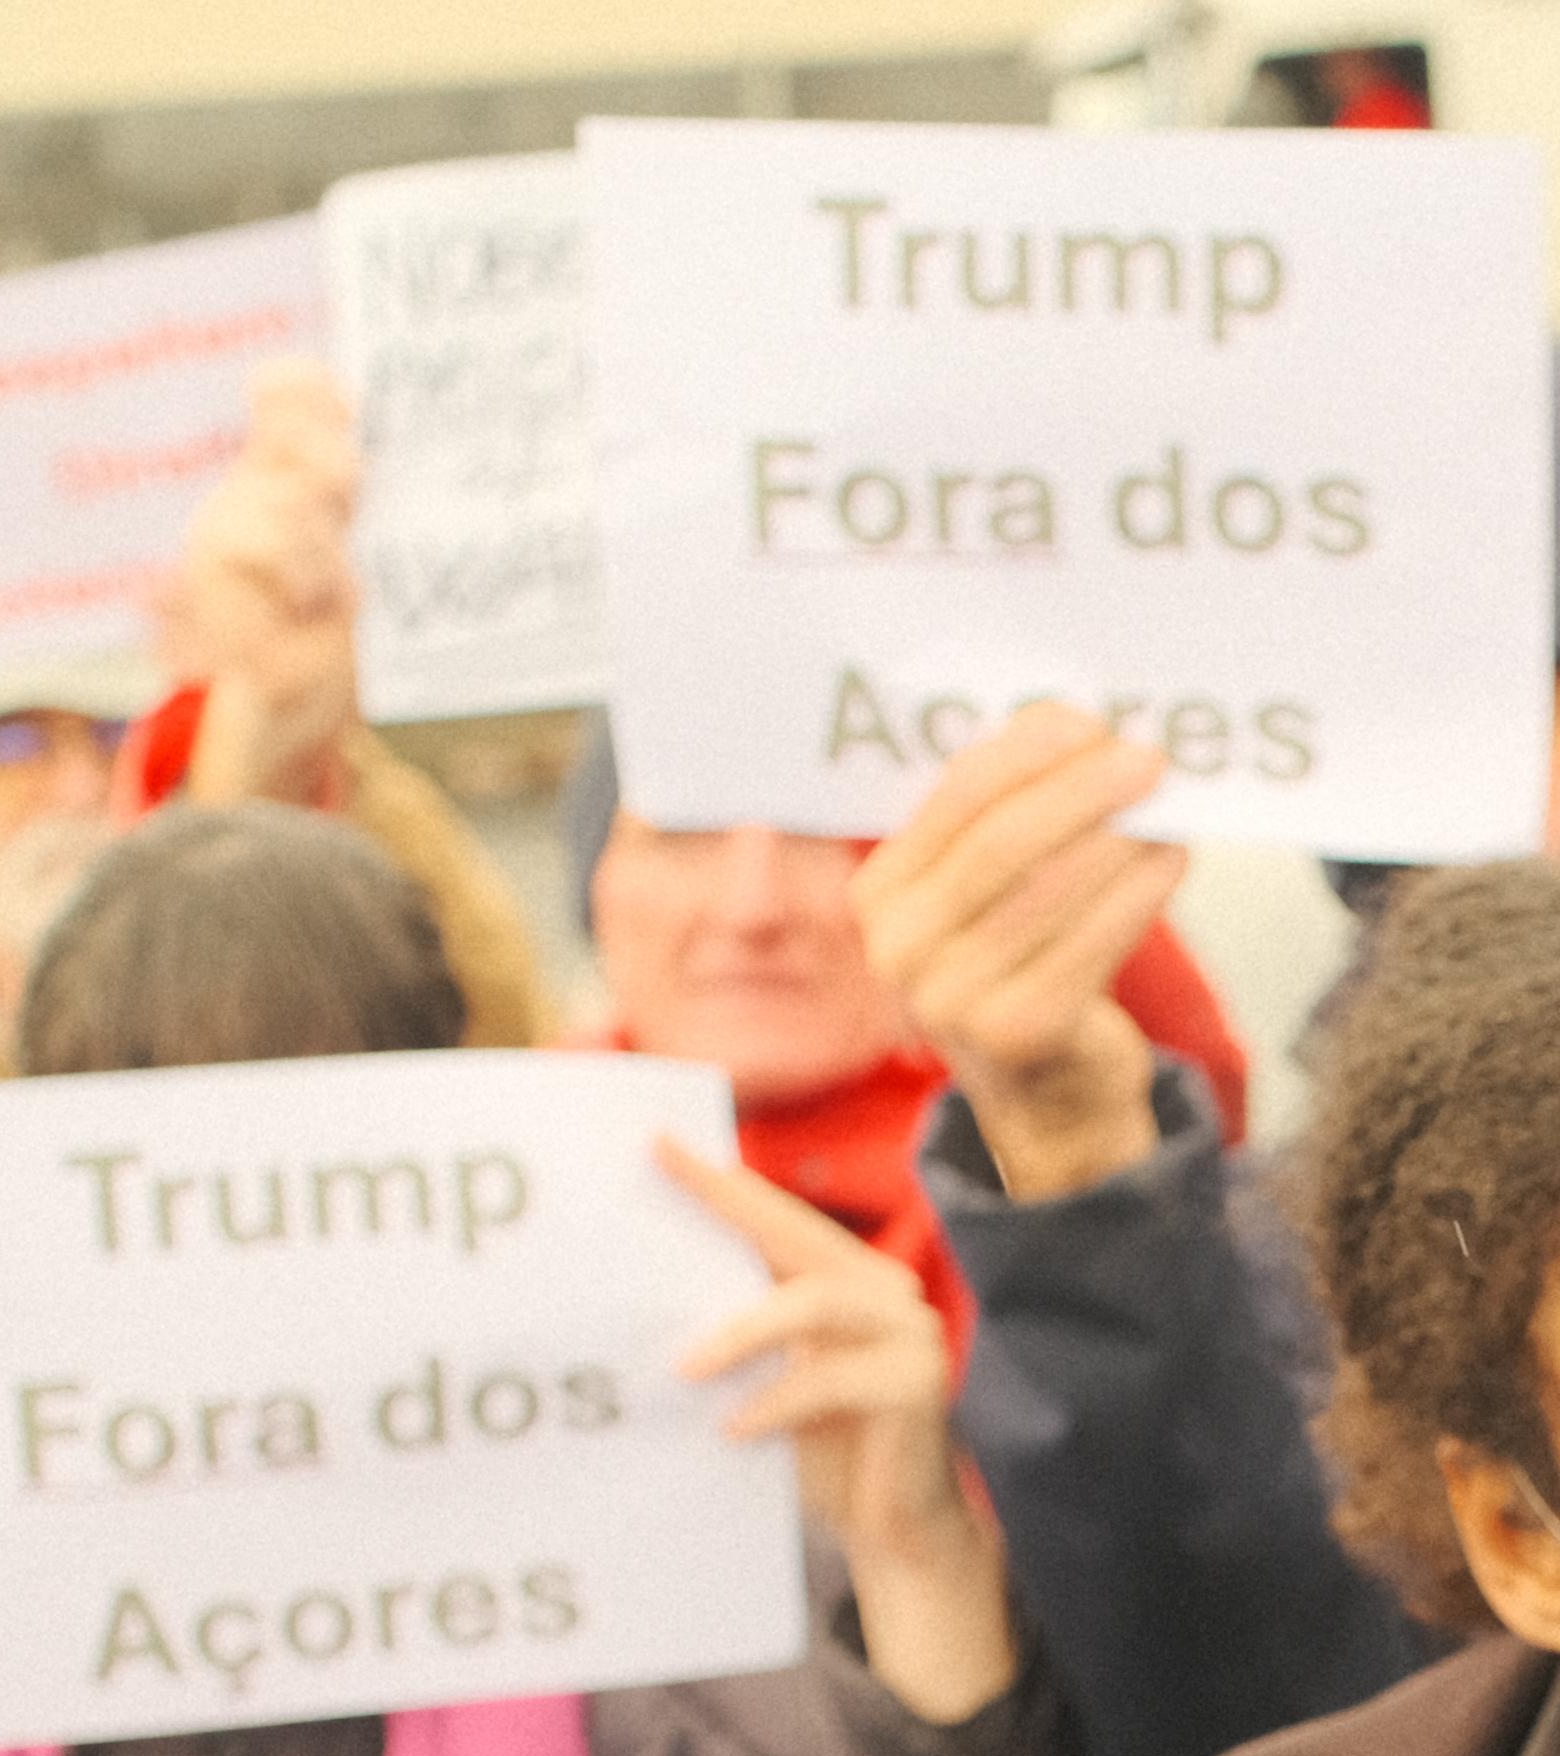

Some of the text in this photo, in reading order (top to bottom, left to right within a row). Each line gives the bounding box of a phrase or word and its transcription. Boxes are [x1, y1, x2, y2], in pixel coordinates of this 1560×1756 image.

[811, 197, 1289, 345] Trump
[747, 434, 1376, 557] Fora dos
[62, 1146, 530, 1257] Trump
[14, 1356, 627, 1486] Fora dos
[91, 1560, 586, 1696] Açores
